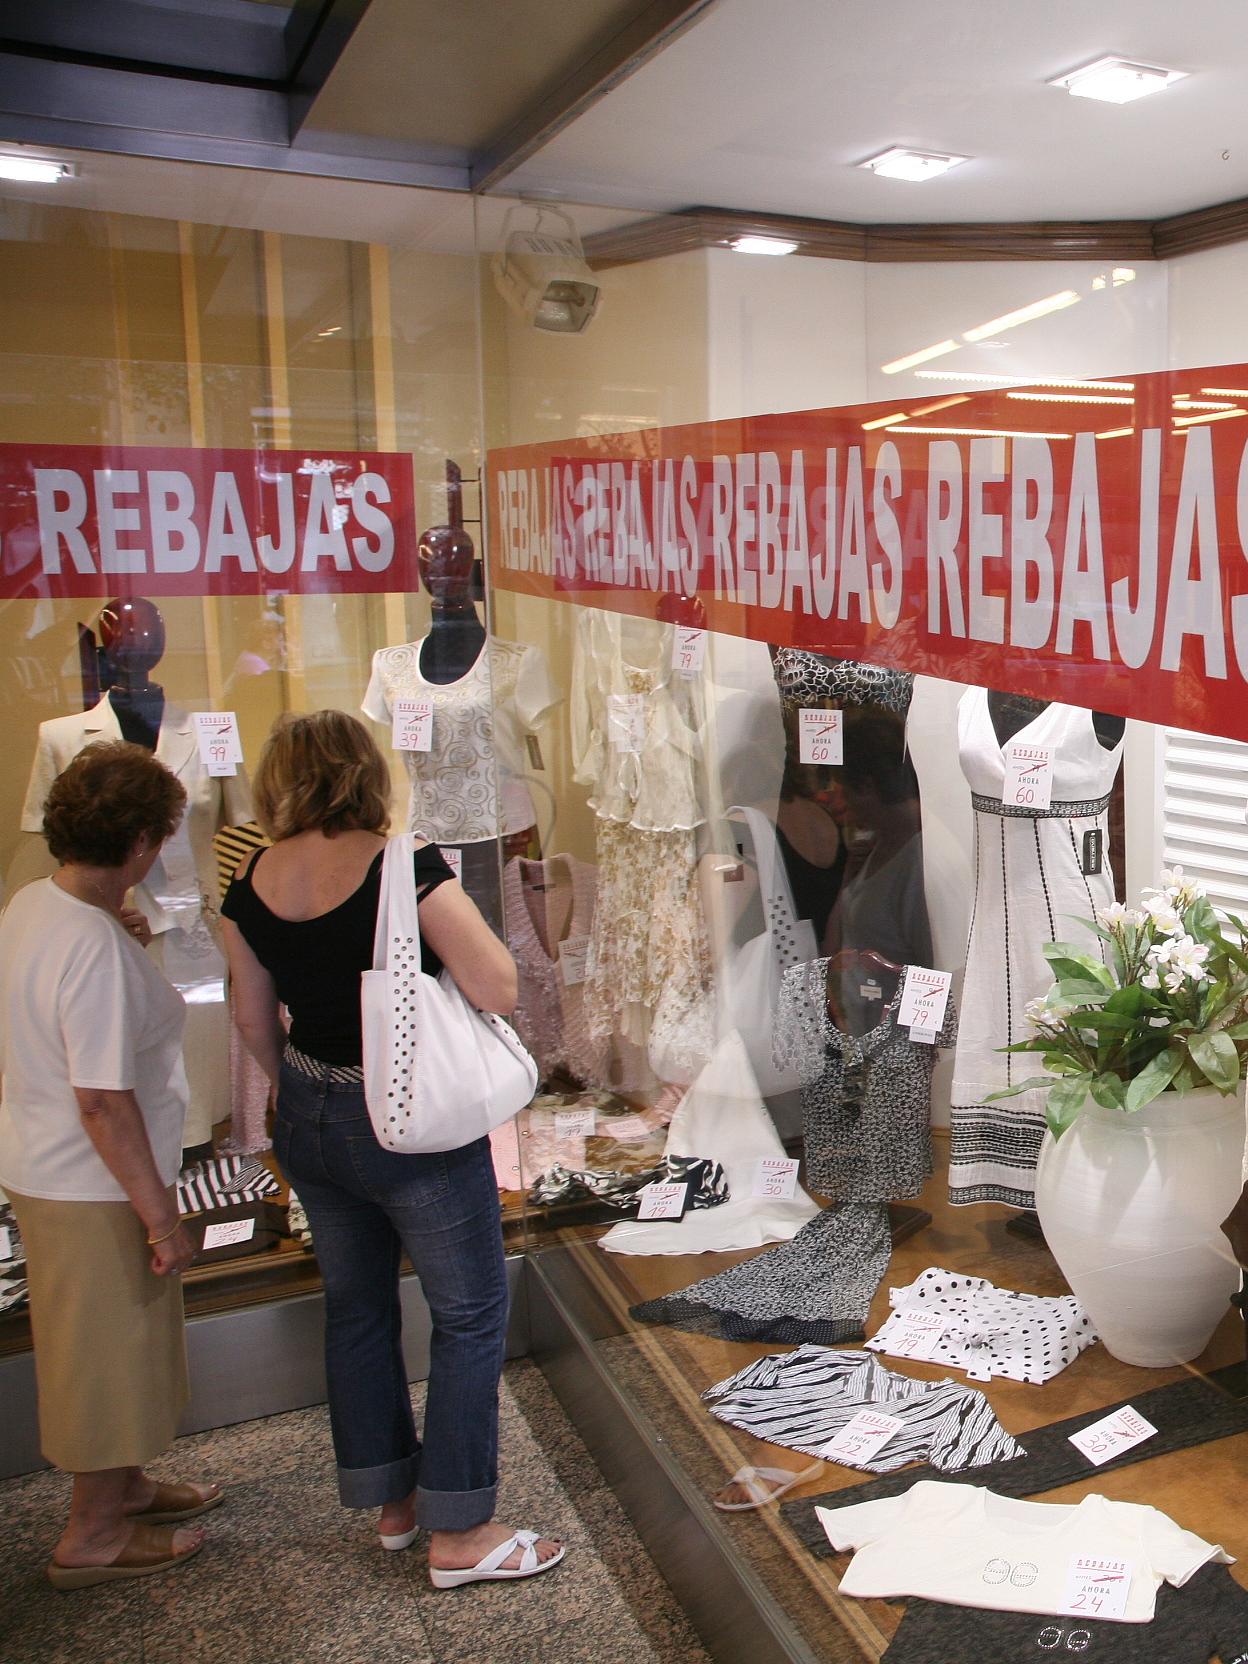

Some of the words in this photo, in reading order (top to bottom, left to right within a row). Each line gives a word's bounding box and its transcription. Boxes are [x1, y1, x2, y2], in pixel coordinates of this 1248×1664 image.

[34, 468, 395, 574] REBAJAS
[498, 463, 577, 580] REBAJAS
[583, 454, 699, 598] REBAJAS
[713, 440, 902, 629] REBAJAS
[679, 652, 692, 668] 79
[399, 732, 418, 749] 39
[209, 746, 226, 761] 99
[811, 746, 829, 760] 60
[1017, 776, 1039, 785] AHORA
[1015, 786, 1035, 803] 60
[911, 1007, 929, 1026] 79
[761, 1183, 782, 1195] 30
[647, 1206, 667, 1217] 19
[895, 1338, 919, 1352] 19
[832, 1440, 862, 1457] 22
[1080, 1434, 1108, 1453] 30
[1081, 1585, 1111, 1595] AHORA
[1069, 1593, 1104, 1613] 24
